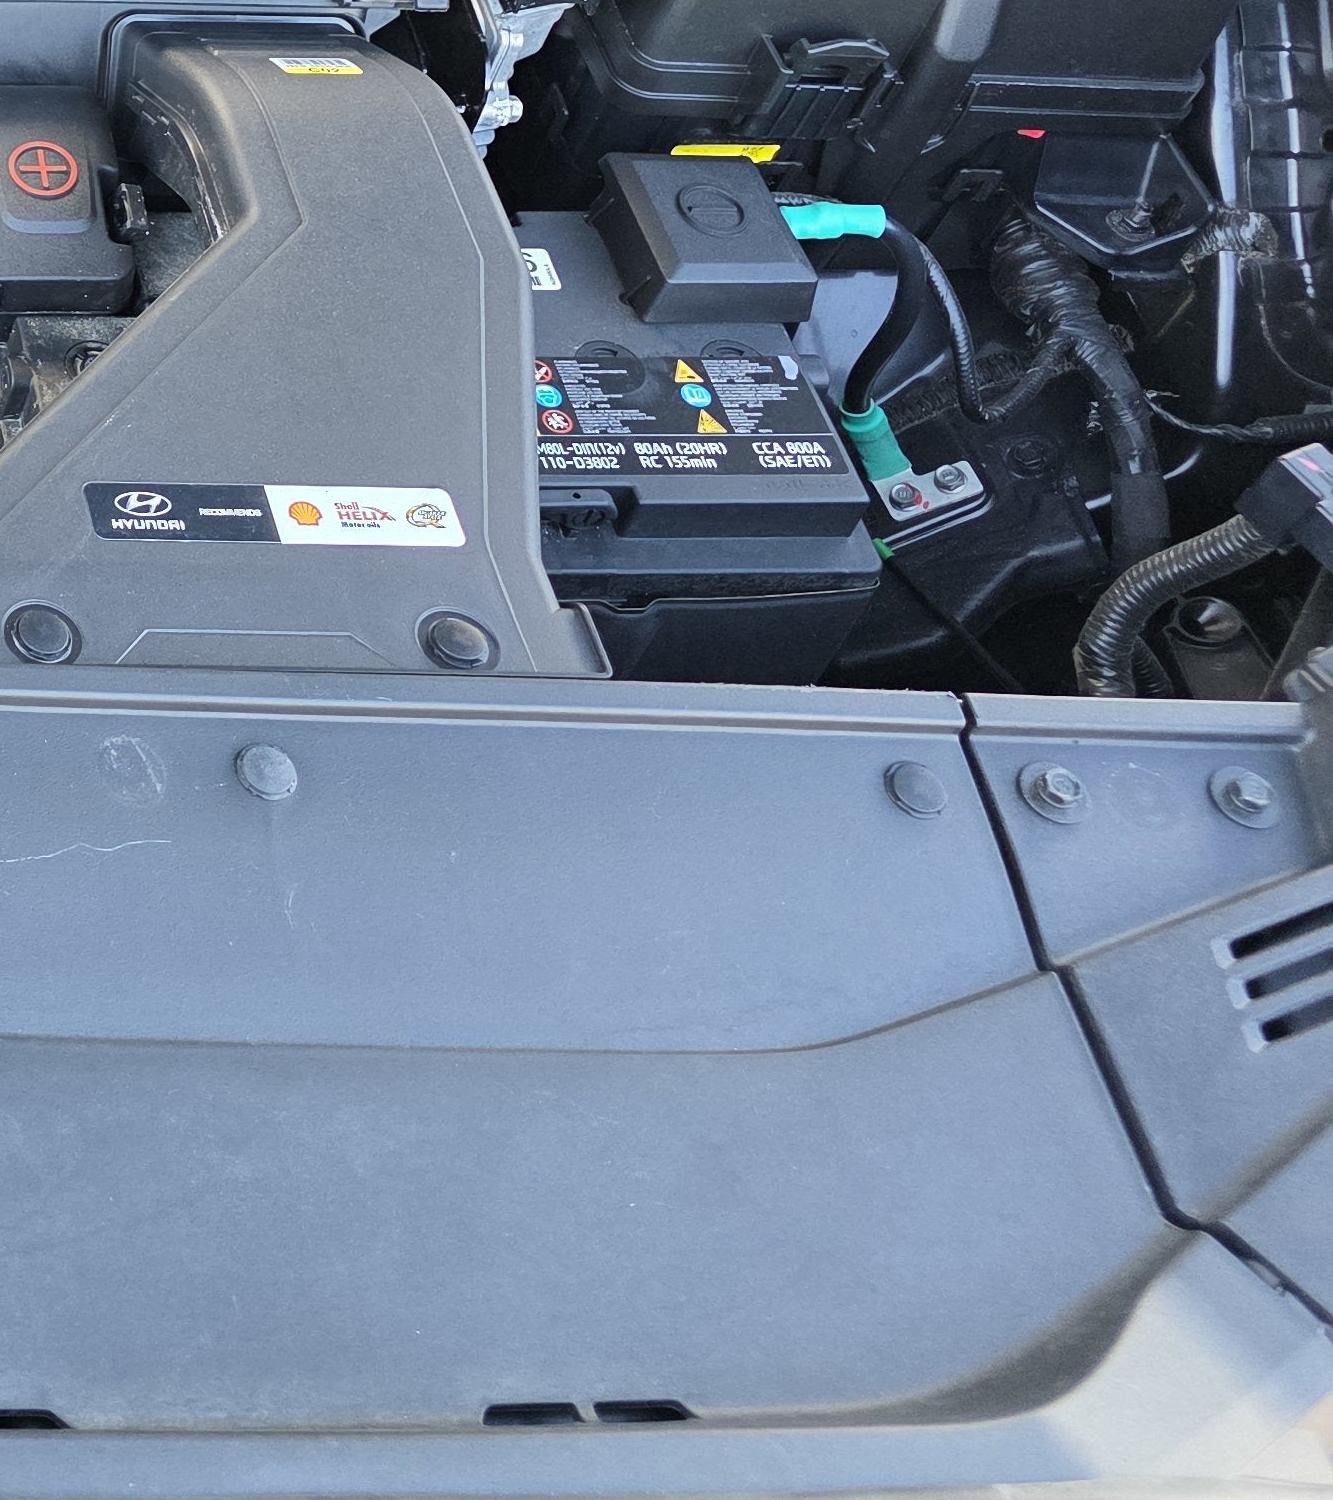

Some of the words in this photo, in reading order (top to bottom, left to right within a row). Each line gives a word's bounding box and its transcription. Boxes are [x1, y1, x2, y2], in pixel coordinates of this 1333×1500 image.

[633, 442, 674, 455] 80Ah
[675, 442, 728, 455] (20HR)
[751, 441, 786, 455] CCA
[787, 441, 826, 455] 800A
[638, 455, 663, 469] RC
[664, 455, 718, 469] 155min
[336, 511, 393, 521] HELIX
[111, 518, 186, 531] HYUNDAI
